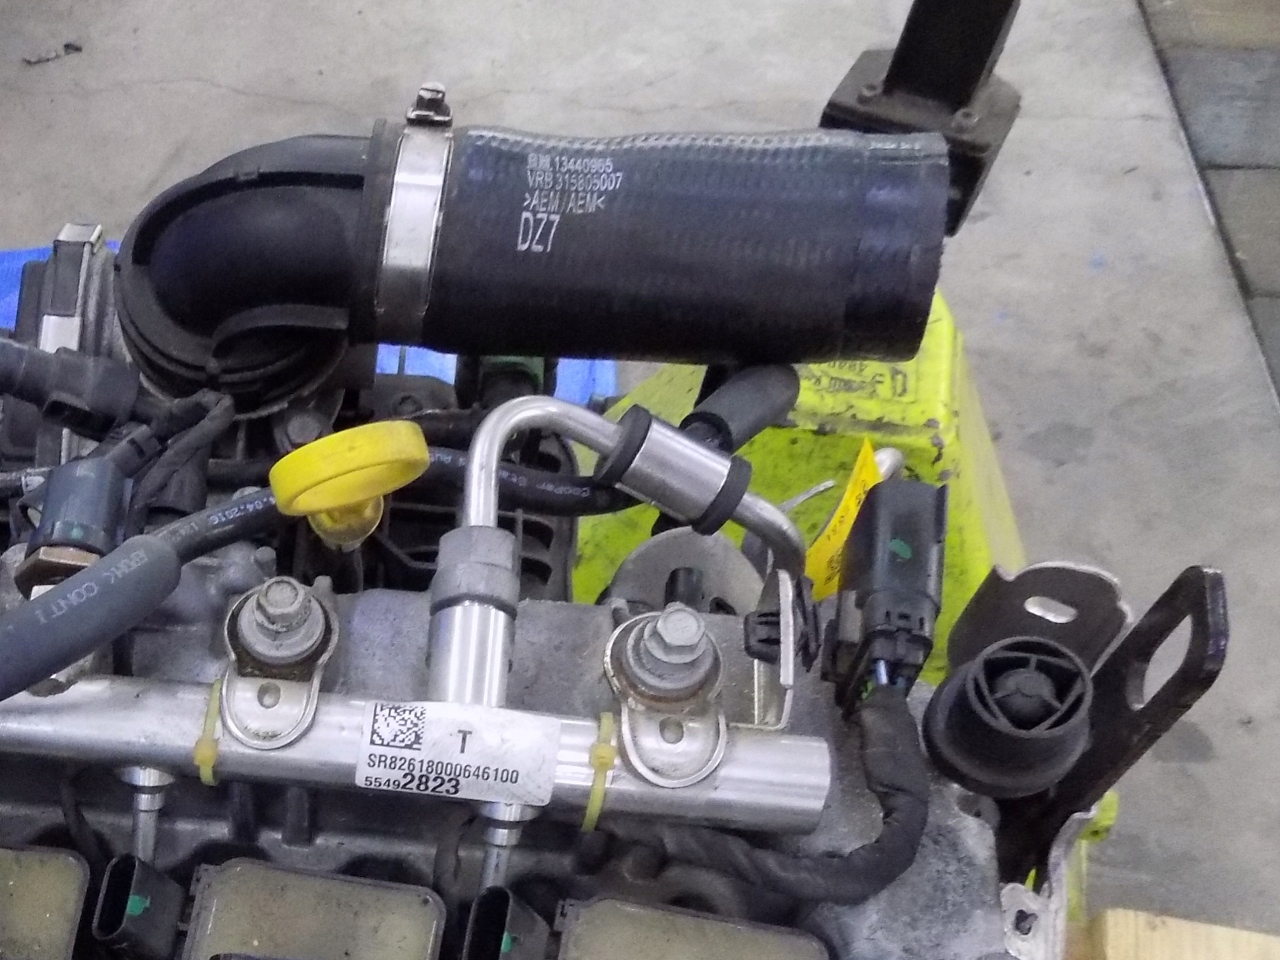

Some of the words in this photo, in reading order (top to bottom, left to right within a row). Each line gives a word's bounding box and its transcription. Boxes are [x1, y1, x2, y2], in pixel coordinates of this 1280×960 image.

[527, 170, 553, 189] VRB
[517, 211, 561, 252] DZ7
[457, 729, 473, 754] T
[367, 753, 519, 784] SR82618000646100
